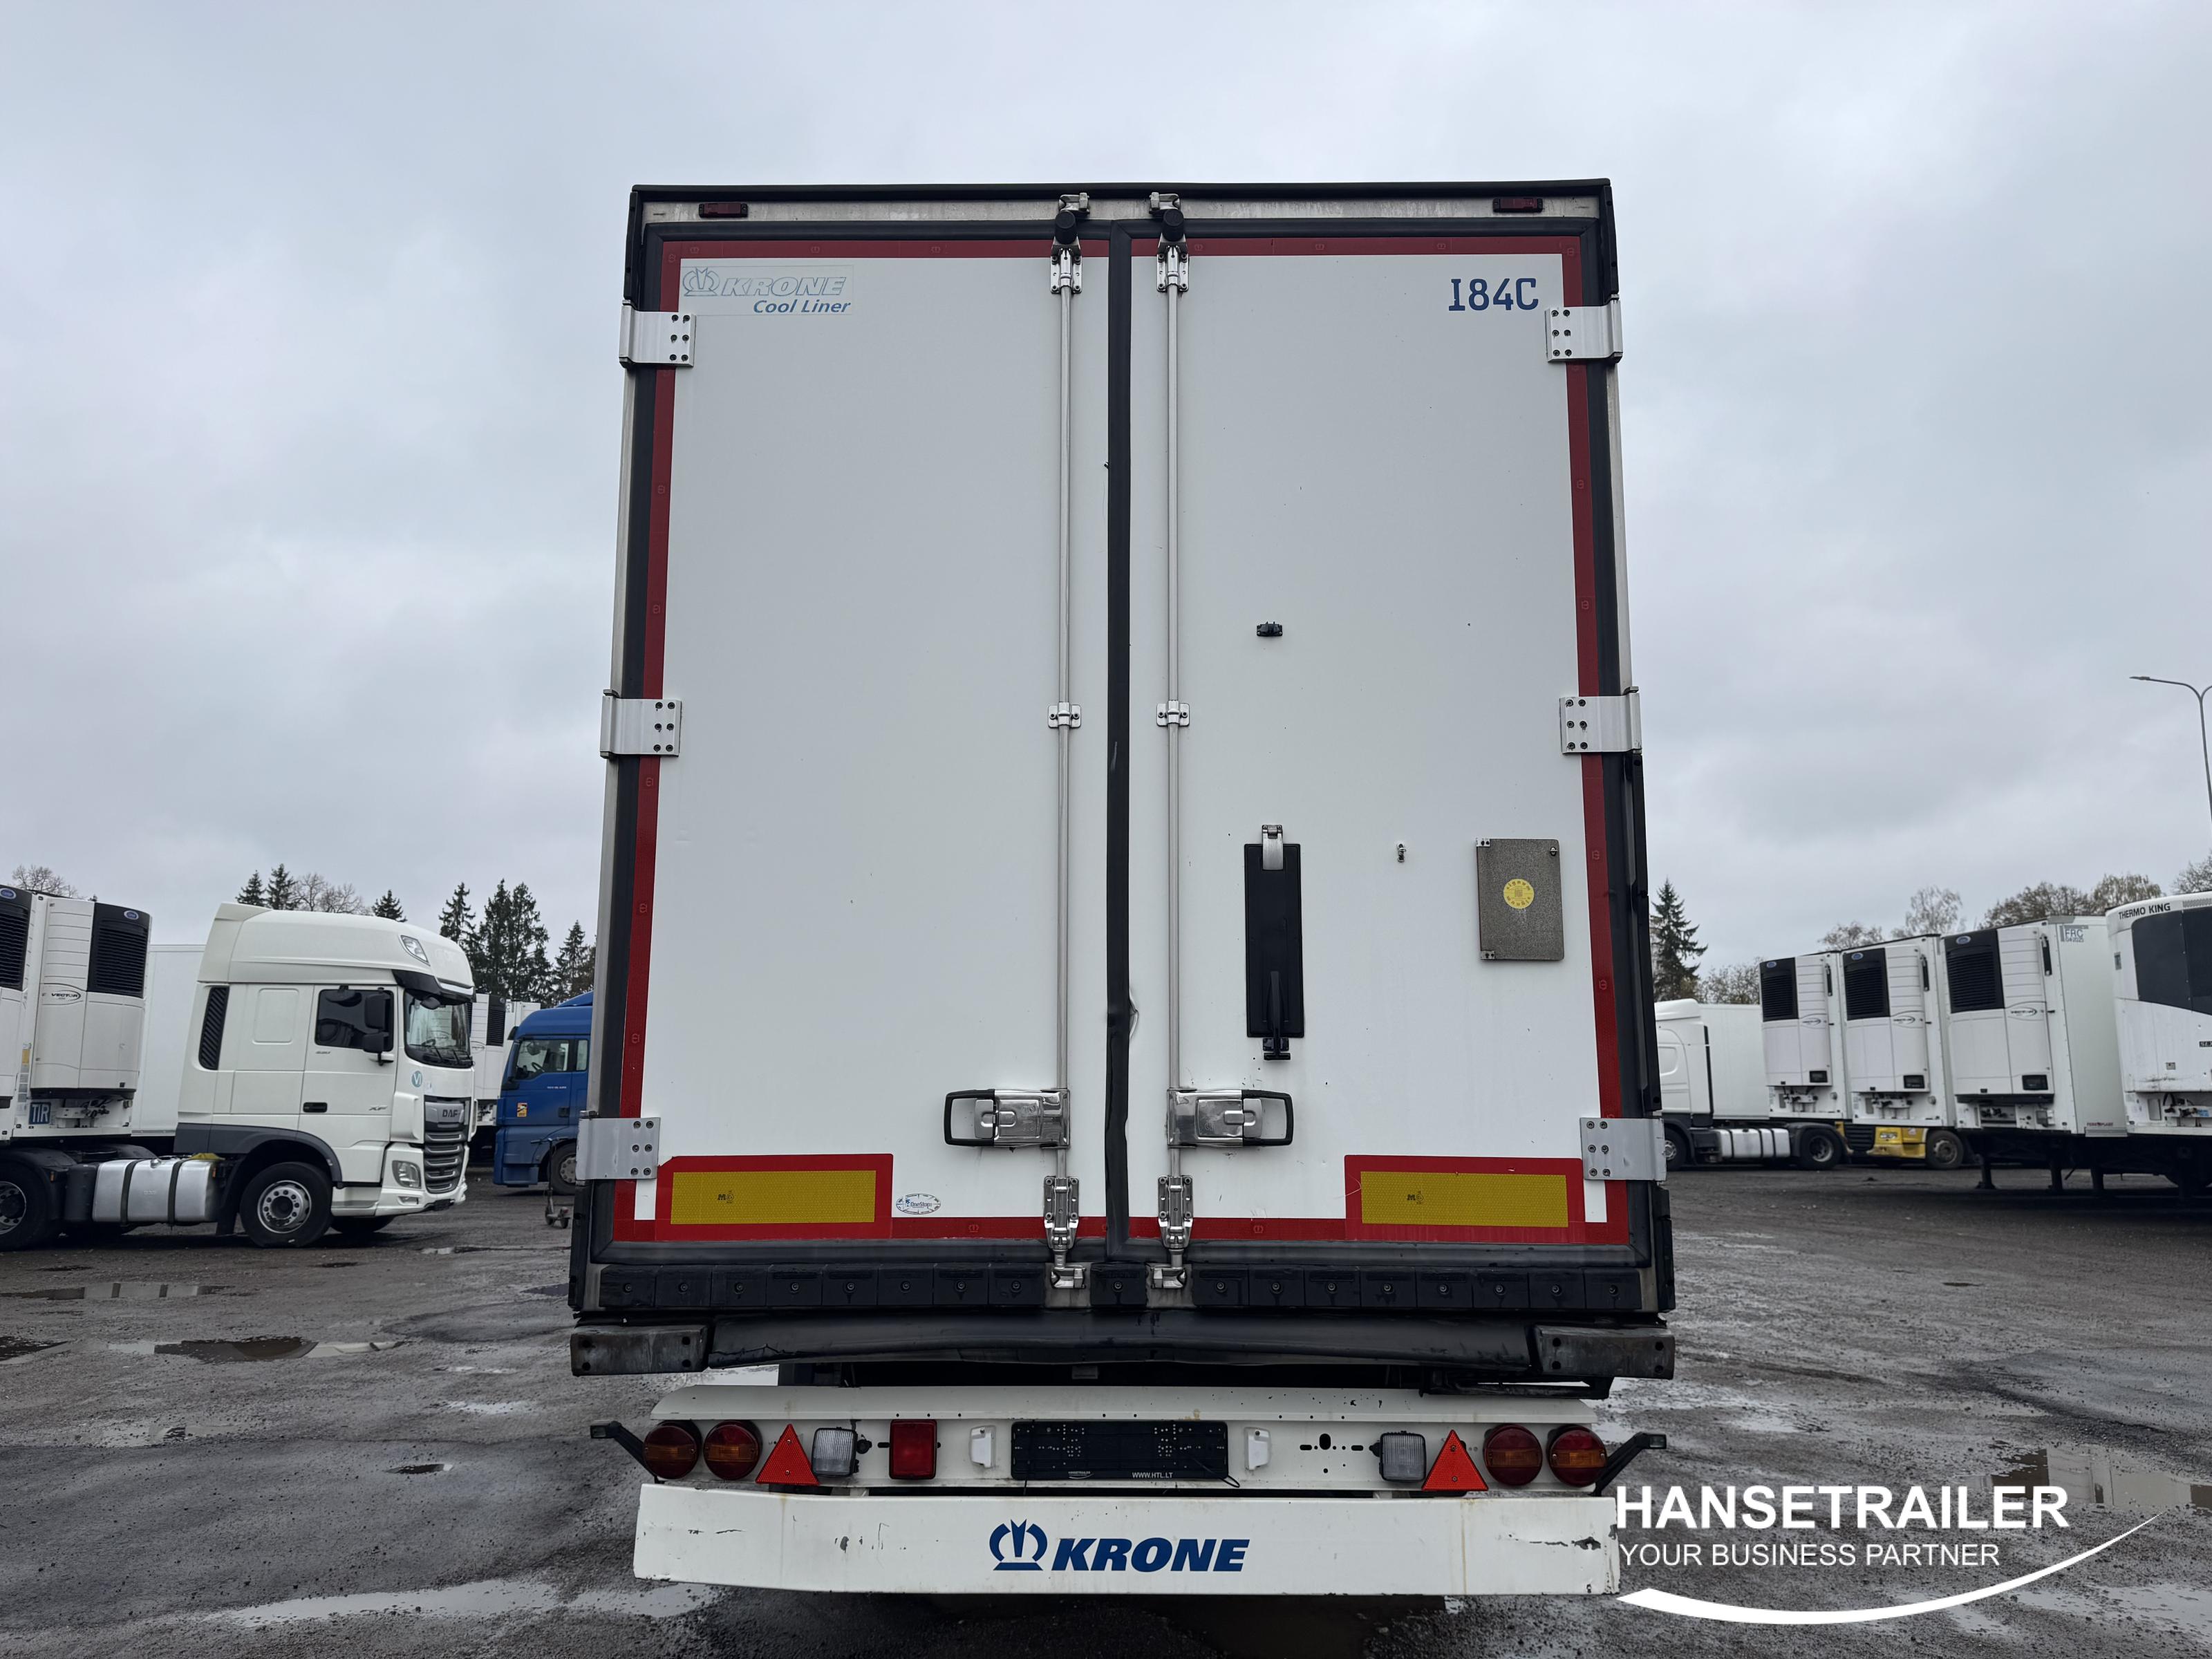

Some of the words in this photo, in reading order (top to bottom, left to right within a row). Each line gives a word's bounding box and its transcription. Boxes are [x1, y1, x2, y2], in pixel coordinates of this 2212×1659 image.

[720, 276, 847, 297] KRONE
[753, 299, 798, 314] Cool
[801, 299, 852, 314] Liner
[2118, 906, 2146, 920] THERMO
[2148, 902, 2171, 915] KING
[2065, 928, 2084, 938] FRC
[31, 1103, 50, 1123] TIR
[442, 1109, 458, 1118] DAF
[1051, 1537, 1250, 1573] KRONE
